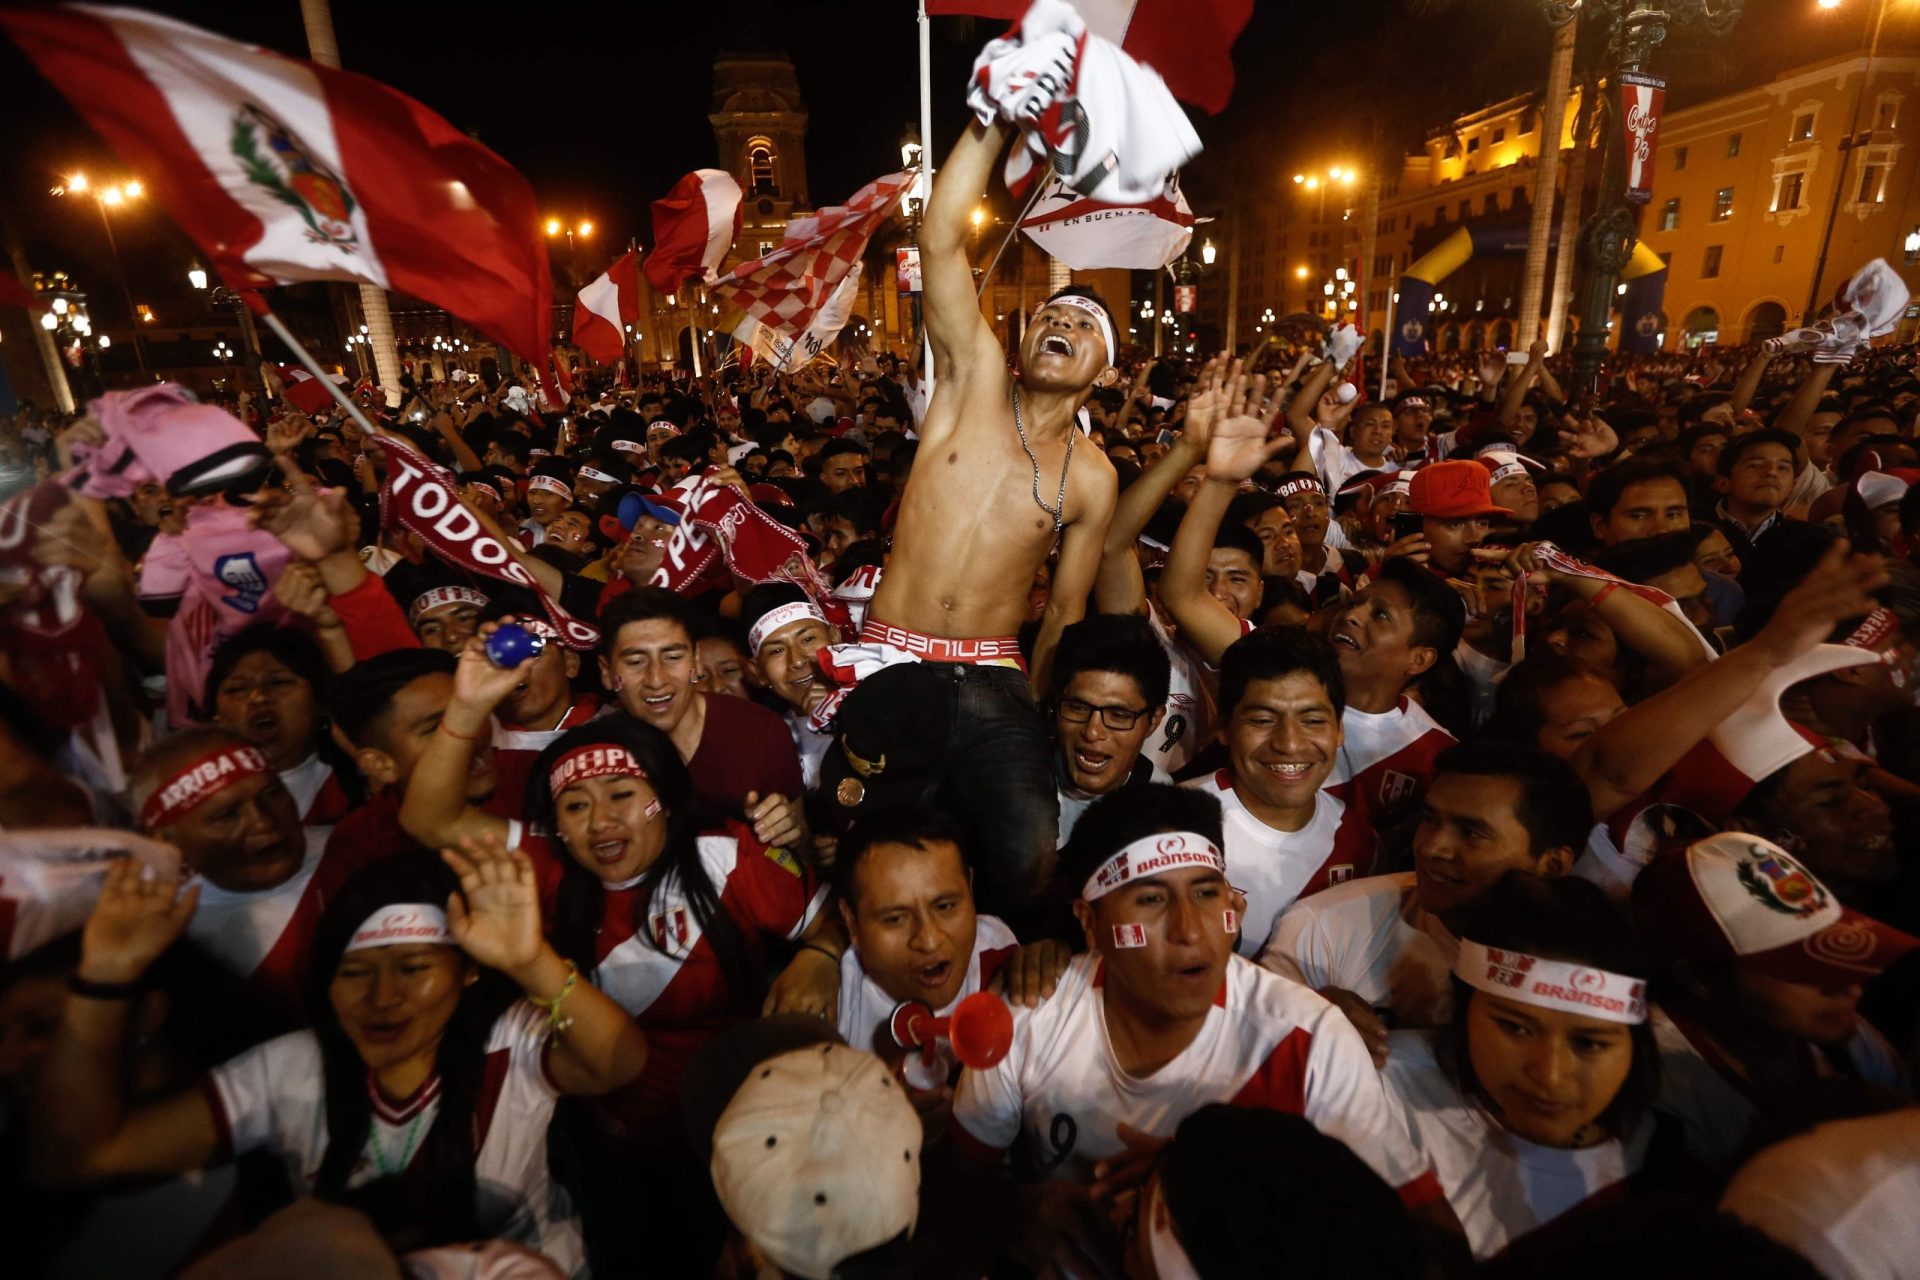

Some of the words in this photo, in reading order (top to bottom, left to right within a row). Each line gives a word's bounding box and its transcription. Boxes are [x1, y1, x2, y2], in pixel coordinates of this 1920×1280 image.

[1064, 217, 1079, 227] EN
[392, 457, 537, 586] TODOS
[1169, 702, 1192, 713] umbro
[1158, 713, 1187, 753] 9
[160, 755, 236, 812] ARRIBA
[582, 767, 629, 778] RUSIA
